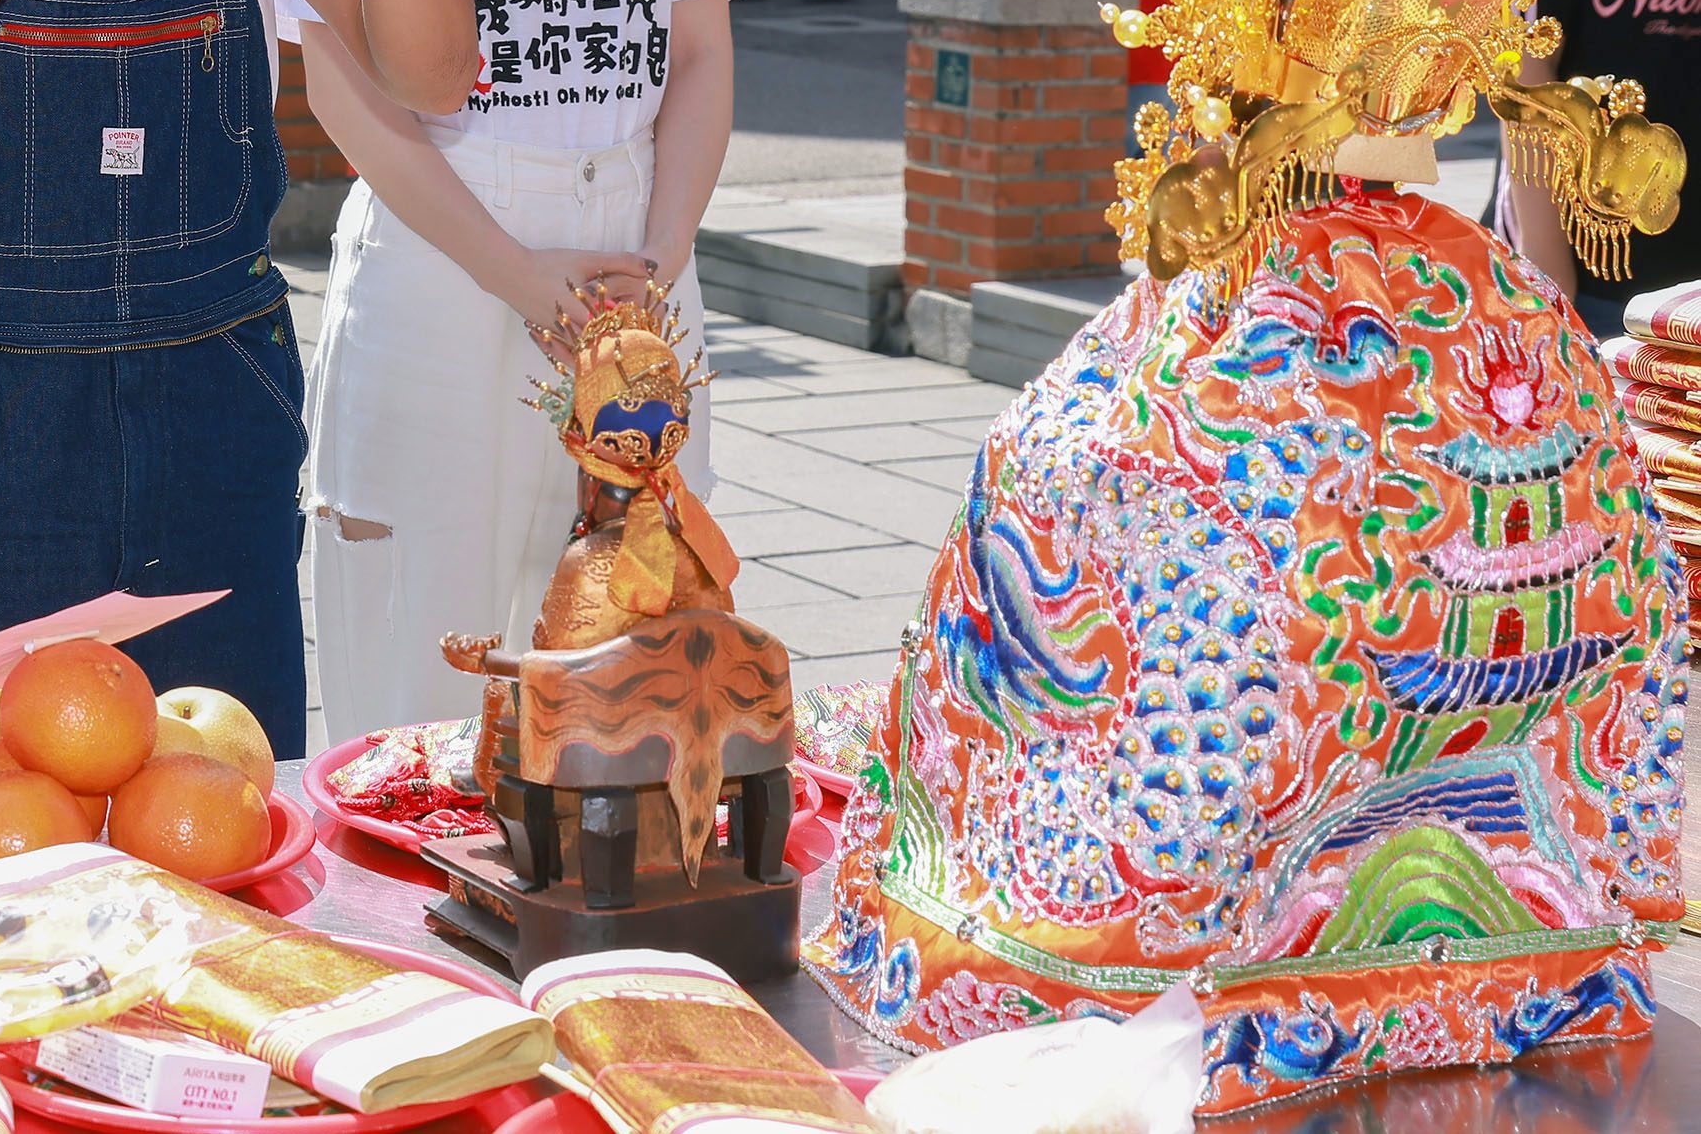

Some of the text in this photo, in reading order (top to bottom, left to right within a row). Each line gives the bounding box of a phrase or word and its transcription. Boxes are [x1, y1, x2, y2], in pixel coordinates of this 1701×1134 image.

[467, 94, 492, 114] My
[557, 88, 580, 105] Oh
[585, 85, 610, 105] My
[108, 131, 140, 142] POINTER
[184, 1083, 208, 1098] CITY
